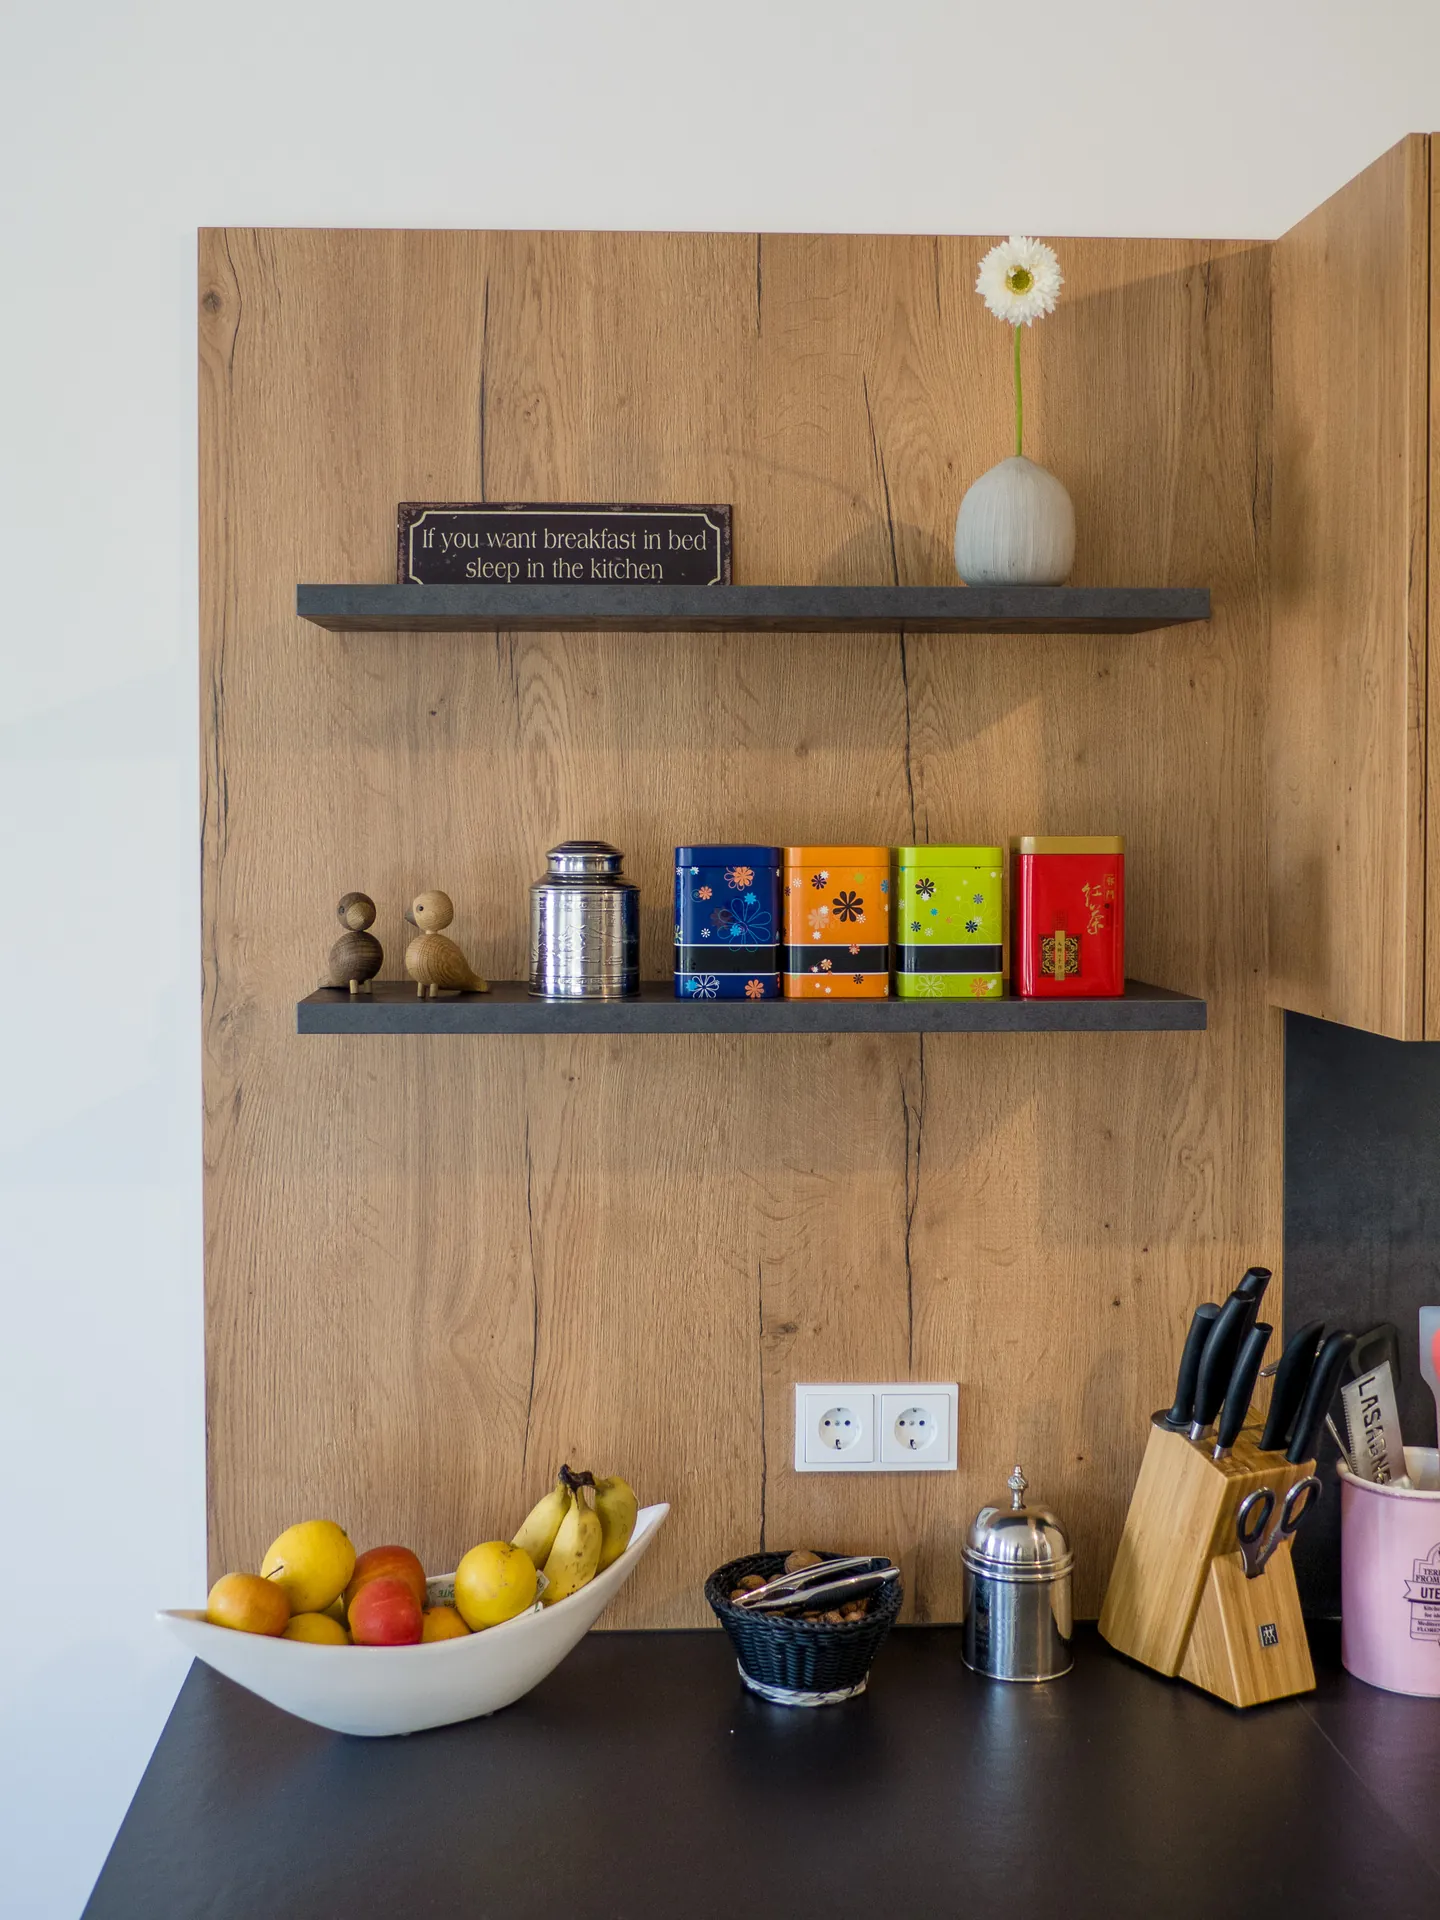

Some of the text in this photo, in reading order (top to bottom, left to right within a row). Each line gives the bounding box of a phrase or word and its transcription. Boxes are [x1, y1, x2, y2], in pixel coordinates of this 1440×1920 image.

[423, 528, 706, 553] If you want breakfast in bed
[466, 558, 662, 582] sleep in the kitchen
[1416, 1574, 1439, 1583] FROM
[1421, 1586, 1440, 1599] UTE
